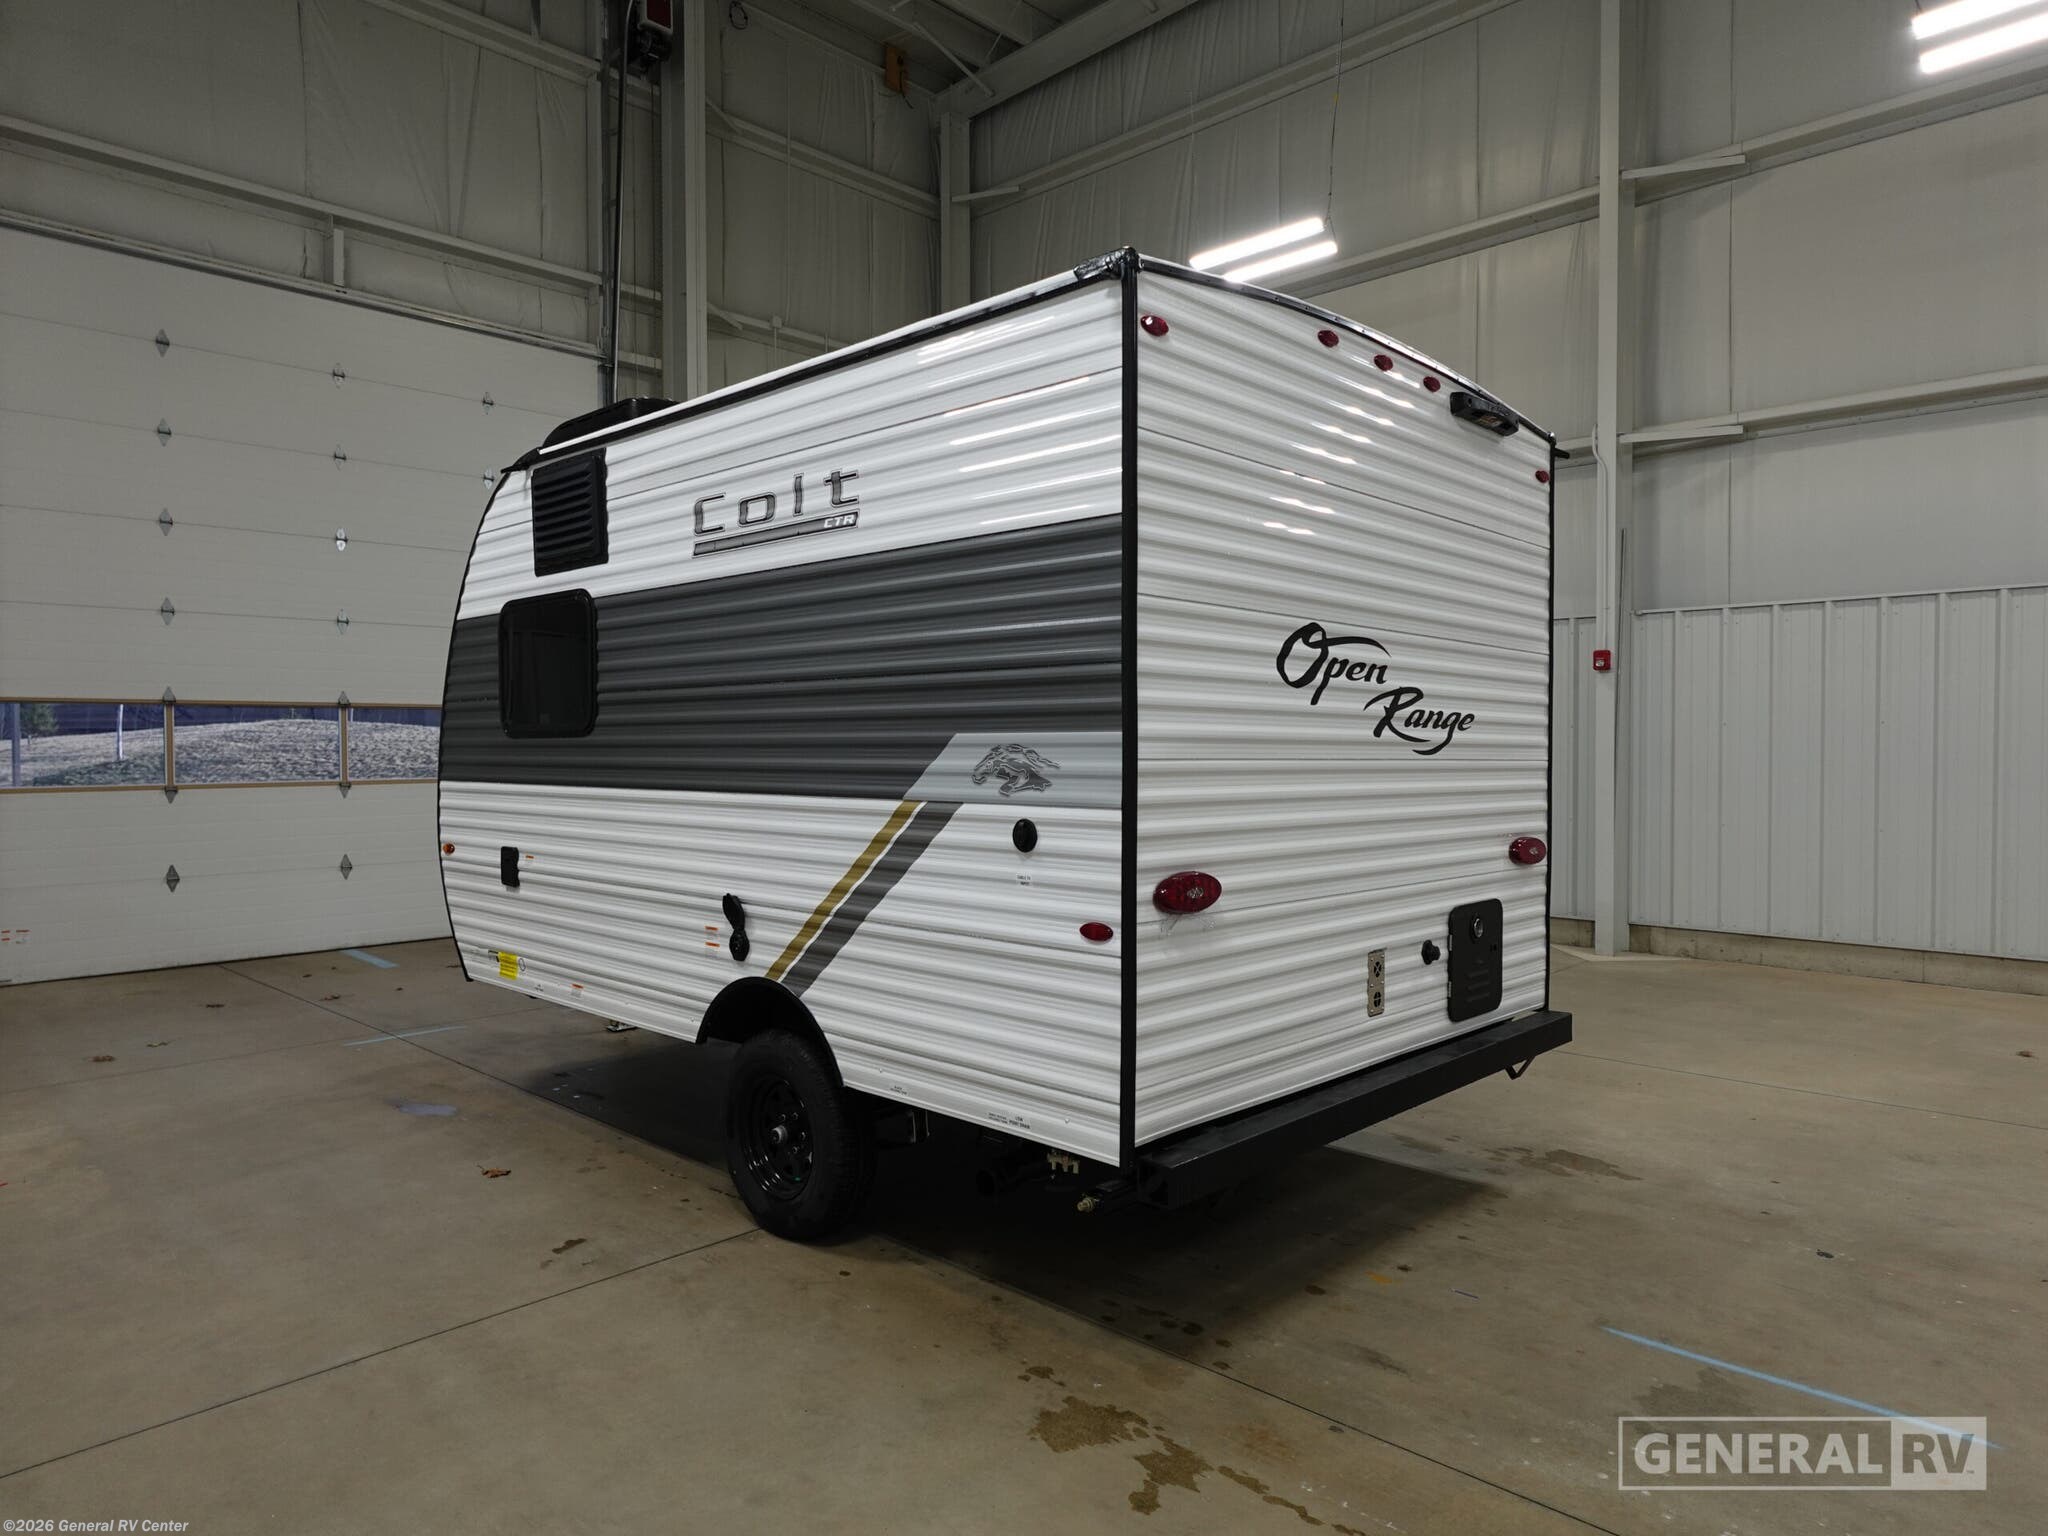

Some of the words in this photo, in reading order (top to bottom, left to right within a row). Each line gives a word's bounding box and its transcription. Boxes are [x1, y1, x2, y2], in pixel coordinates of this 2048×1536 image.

[694, 471, 860, 536] Colt
[1276, 621, 1392, 706] Open
[1363, 686, 1476, 756] Range
